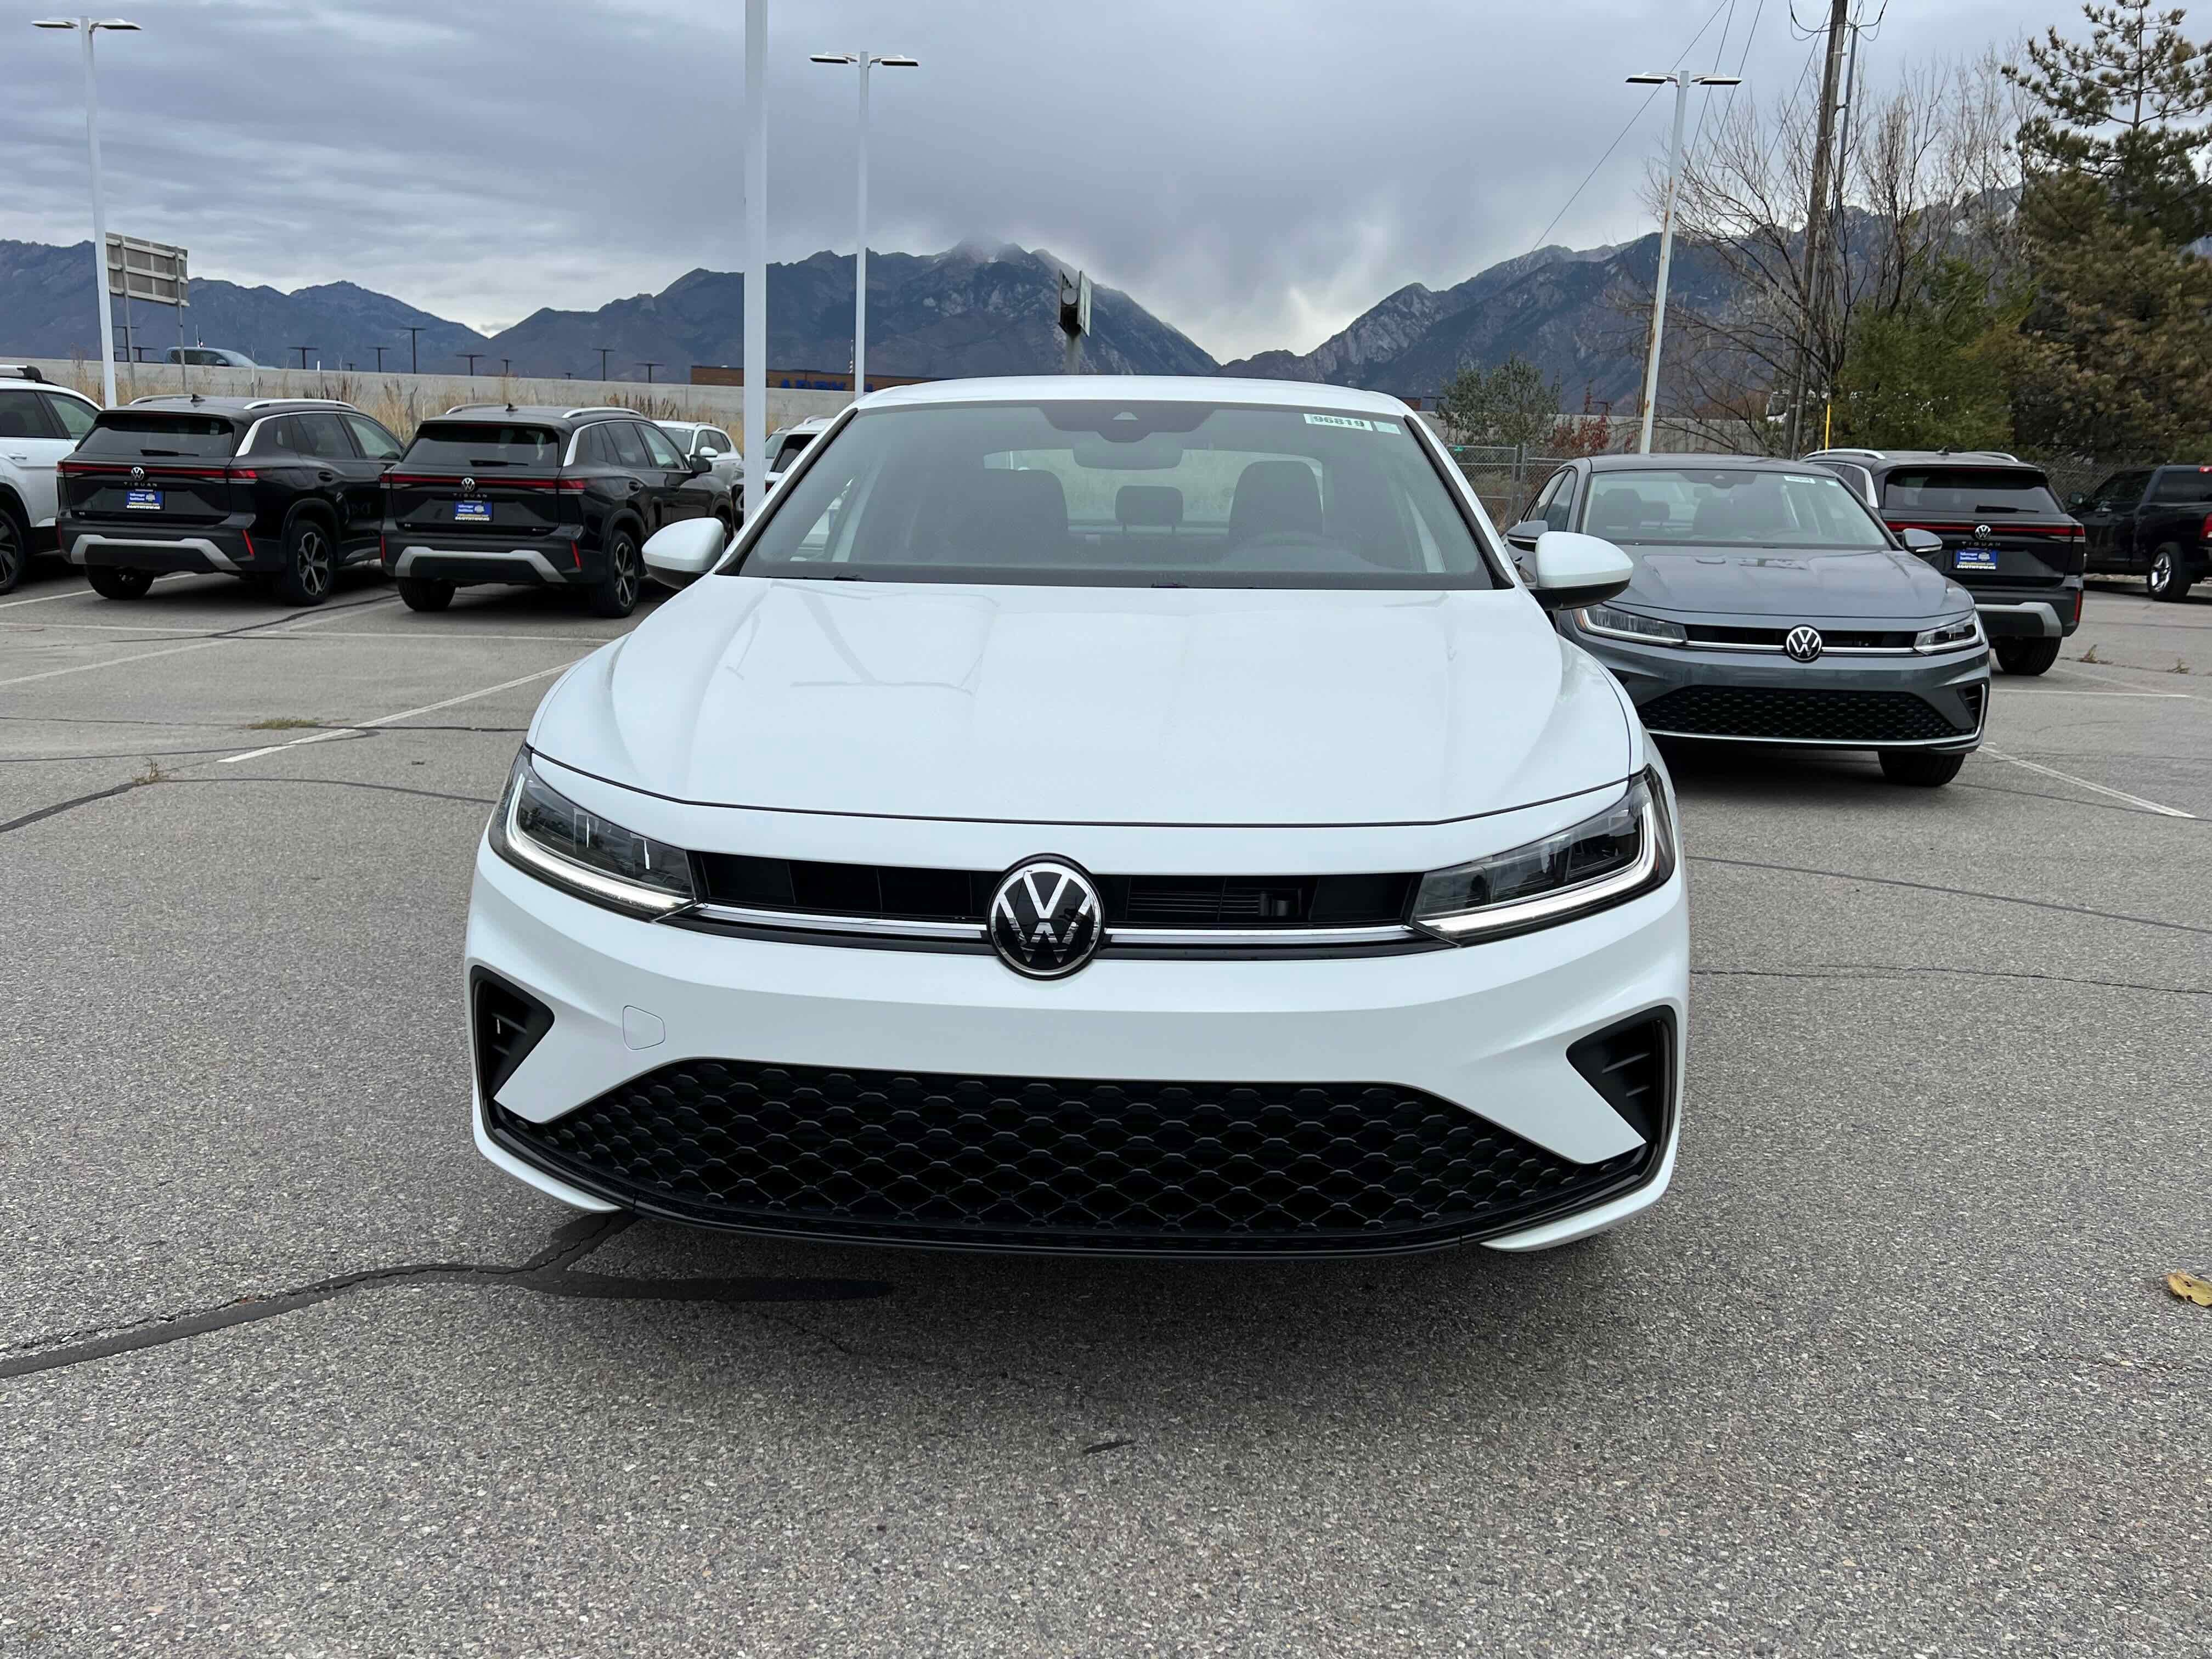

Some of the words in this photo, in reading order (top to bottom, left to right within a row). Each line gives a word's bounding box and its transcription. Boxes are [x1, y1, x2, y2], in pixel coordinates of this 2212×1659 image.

[1313, 416, 1365, 427] 96819
[1786, 626, 1822, 661] VW
[989, 857, 1103, 979] VW
